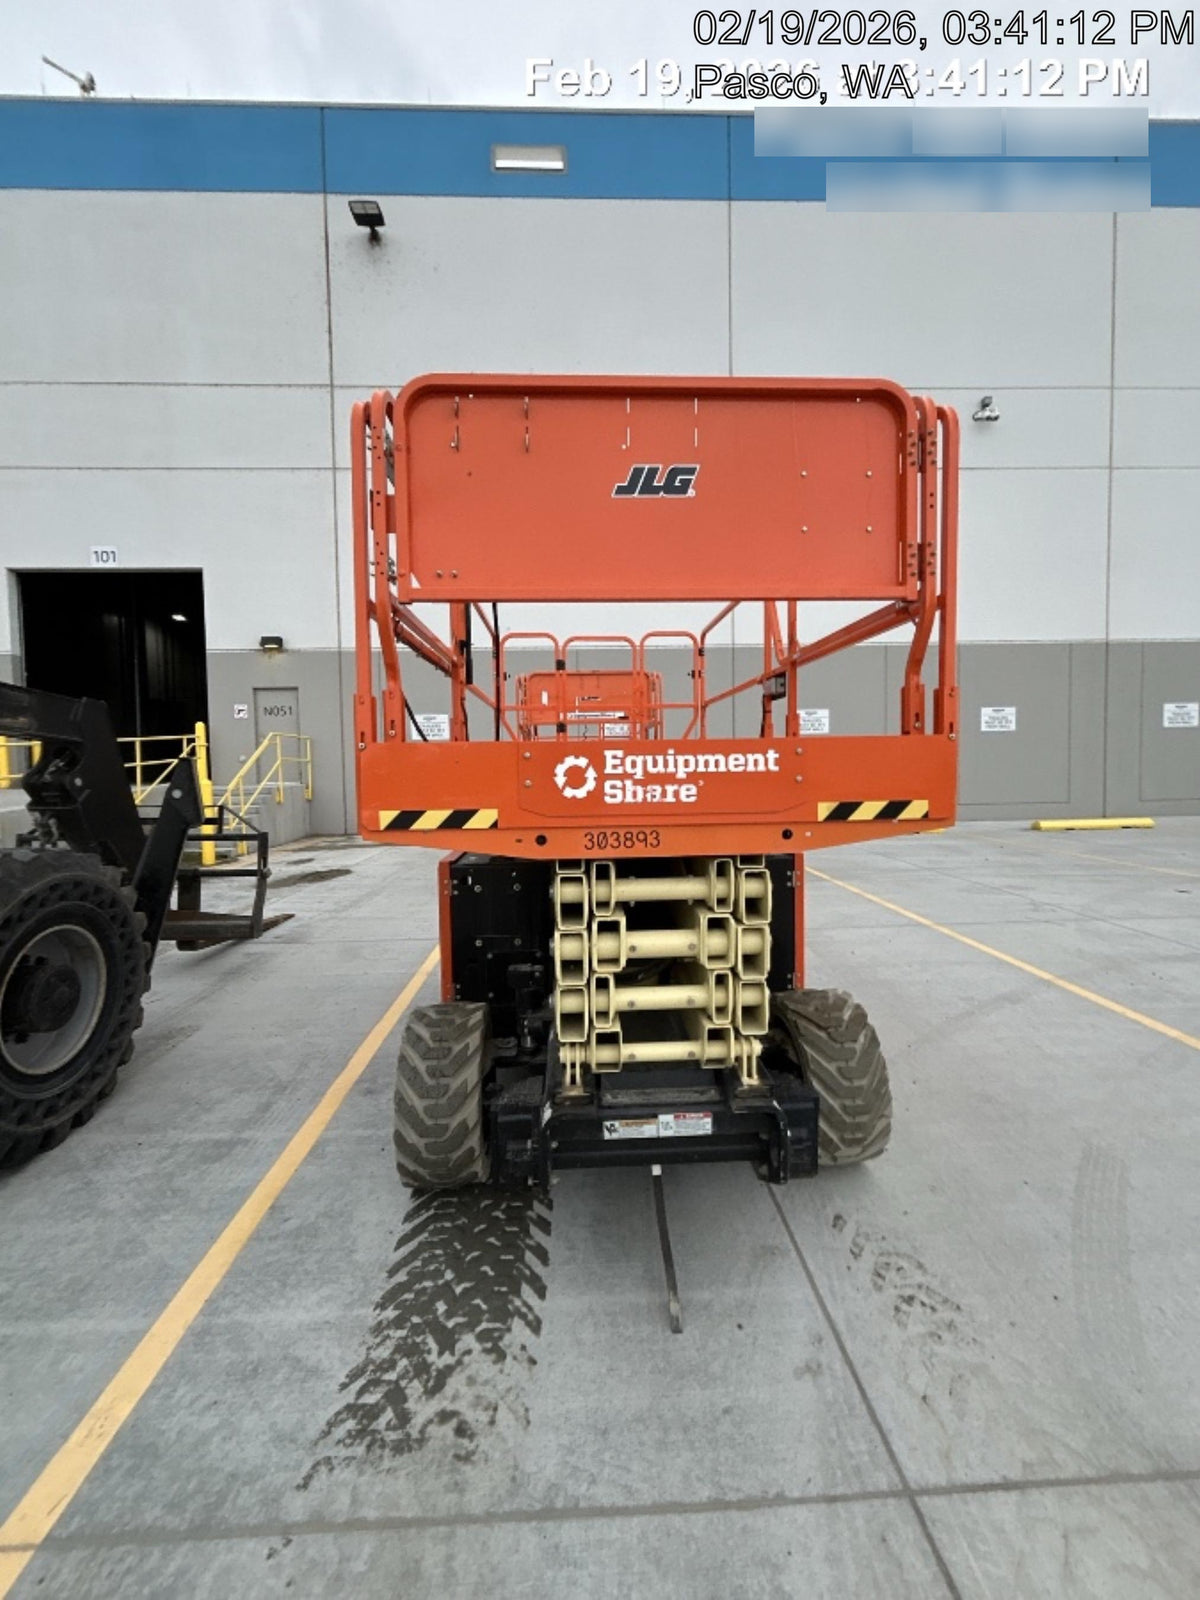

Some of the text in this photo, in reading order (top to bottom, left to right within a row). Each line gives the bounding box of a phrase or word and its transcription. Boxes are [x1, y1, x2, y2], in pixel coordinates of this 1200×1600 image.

[611, 463, 700, 499] JLG
[93, 549, 117, 563] 101
[263, 704, 293, 717] N051
[603, 748, 780, 780] Equipment
[603, 779, 698, 804] Share
[583, 830, 661, 851] 303893
